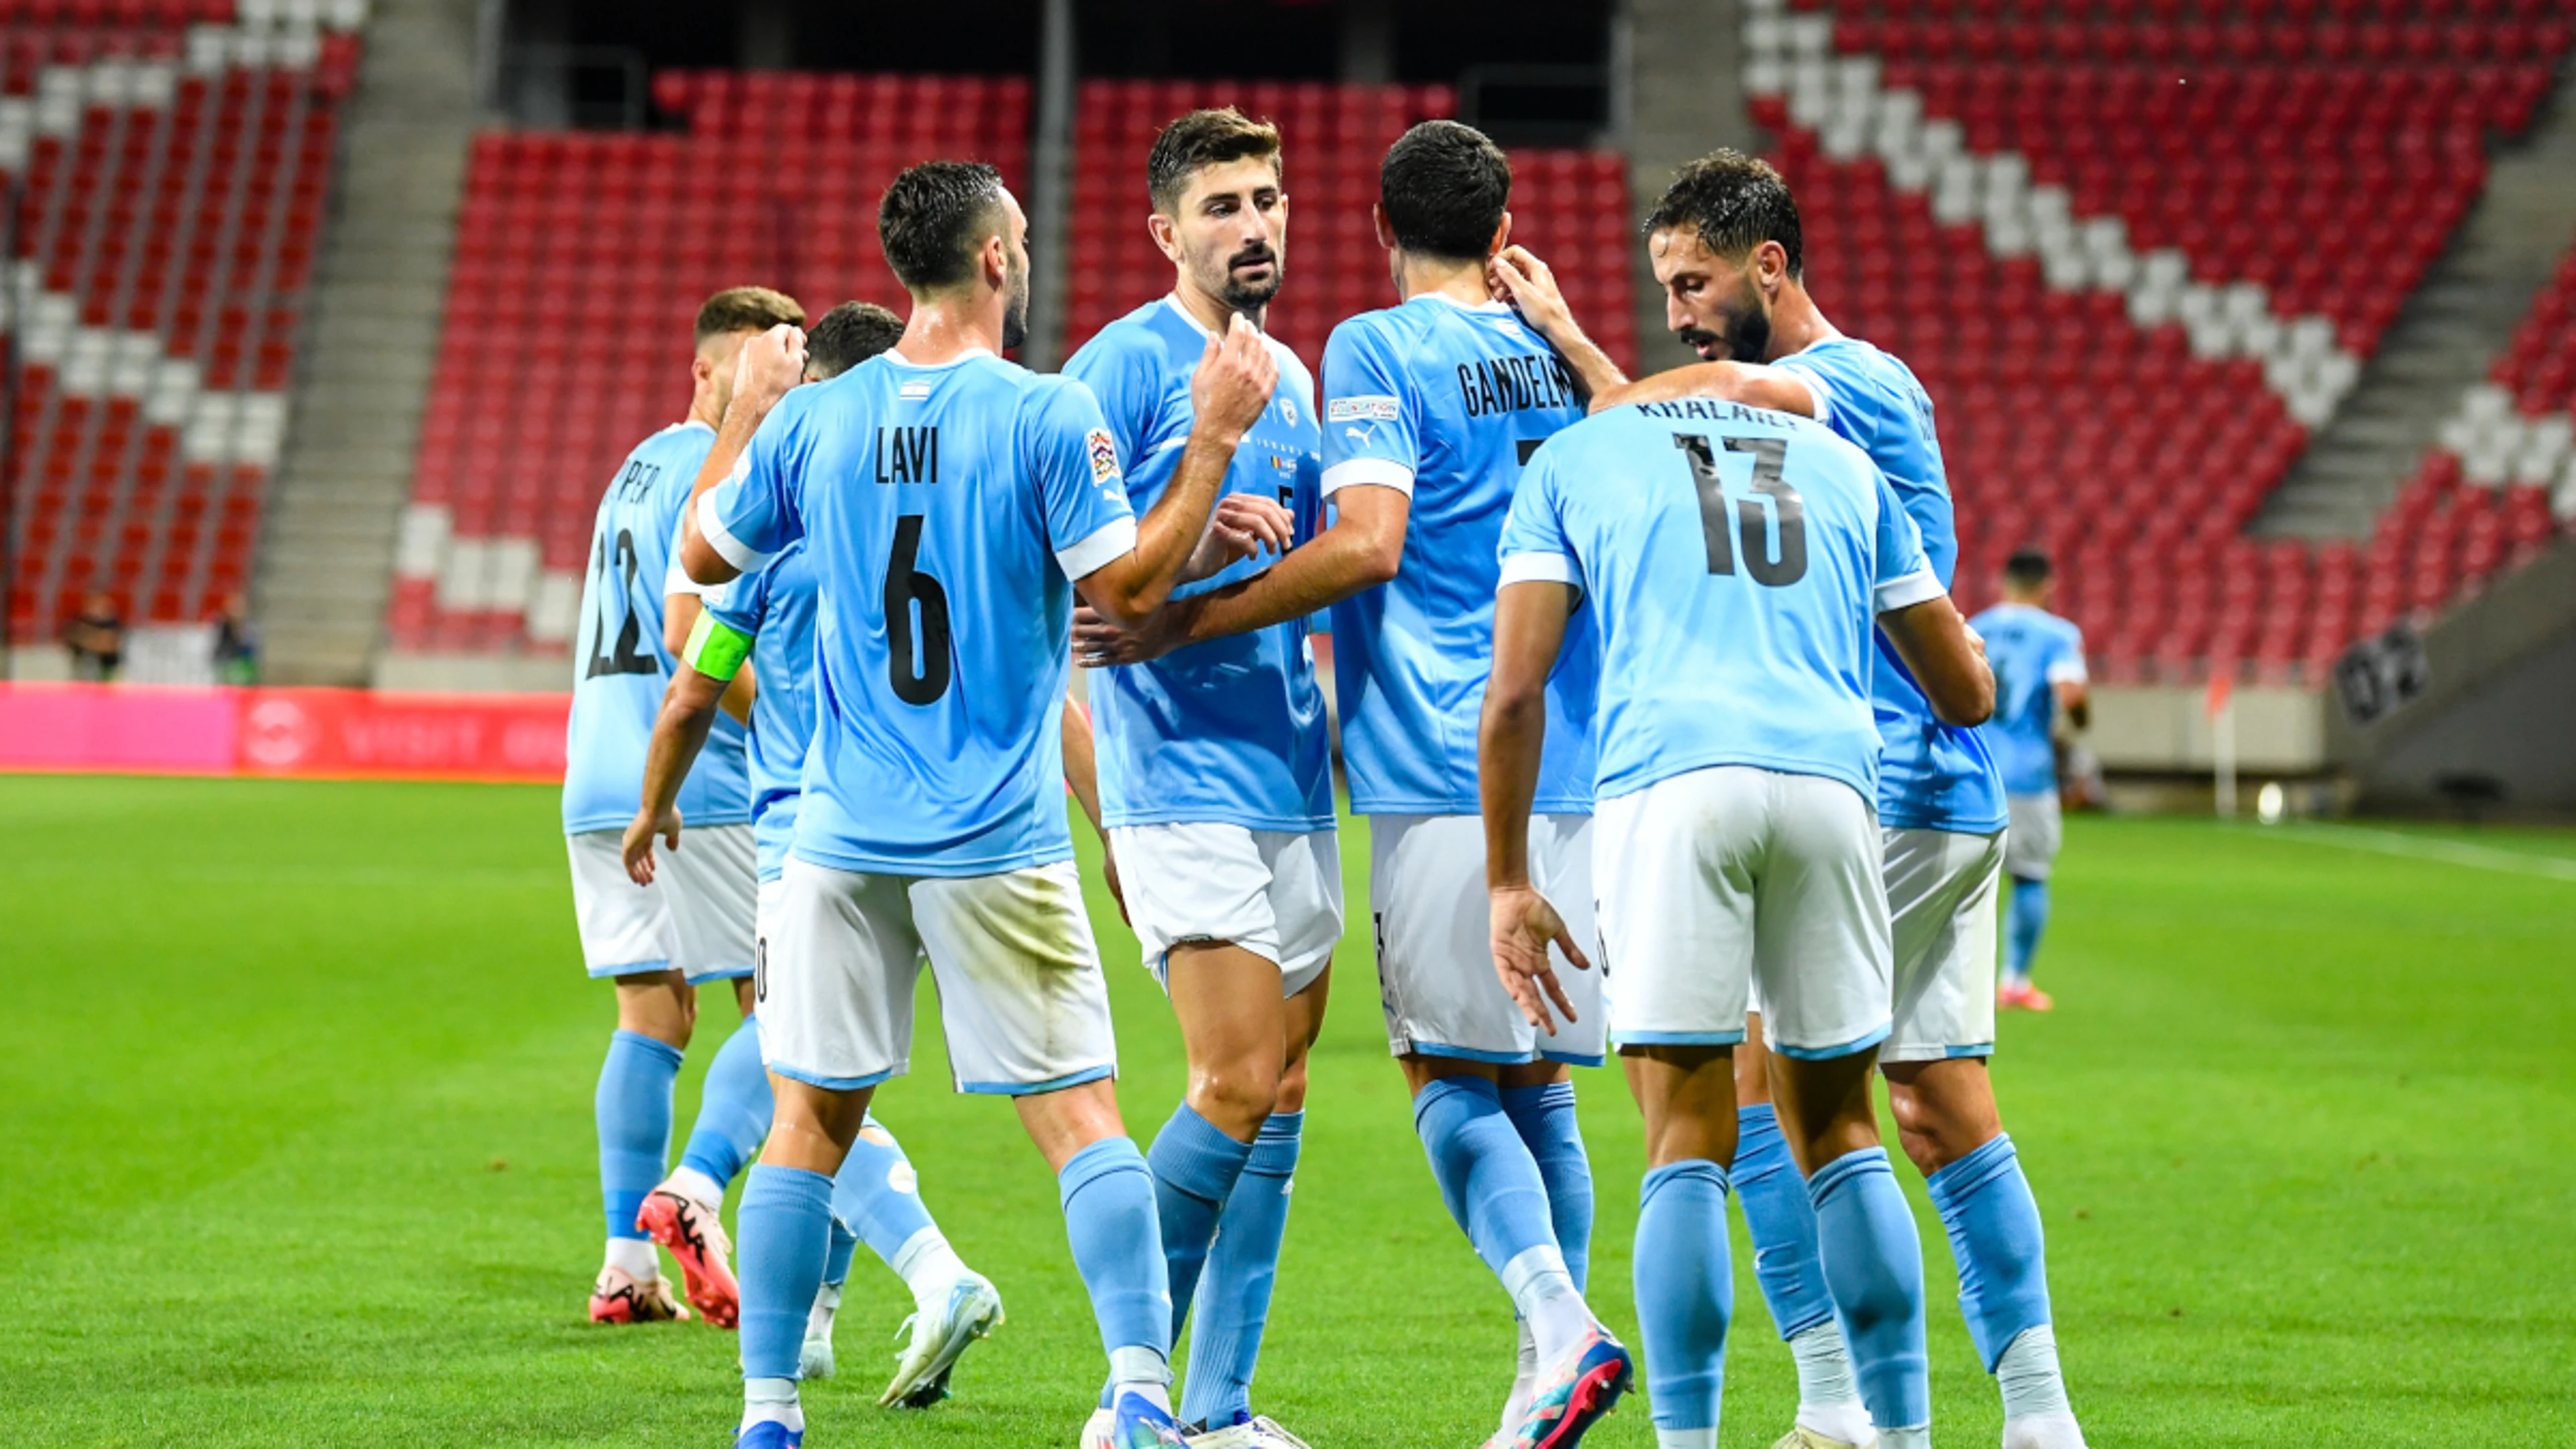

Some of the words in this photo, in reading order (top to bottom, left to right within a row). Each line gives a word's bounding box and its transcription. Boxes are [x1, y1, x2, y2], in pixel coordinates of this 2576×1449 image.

[875, 427, 938, 484] LAVI
[1457, 355, 1585, 417] GANDELM
[1672, 433, 1808, 586] 13
[586, 528, 659, 680] 12
[883, 515, 951, 706] 6
